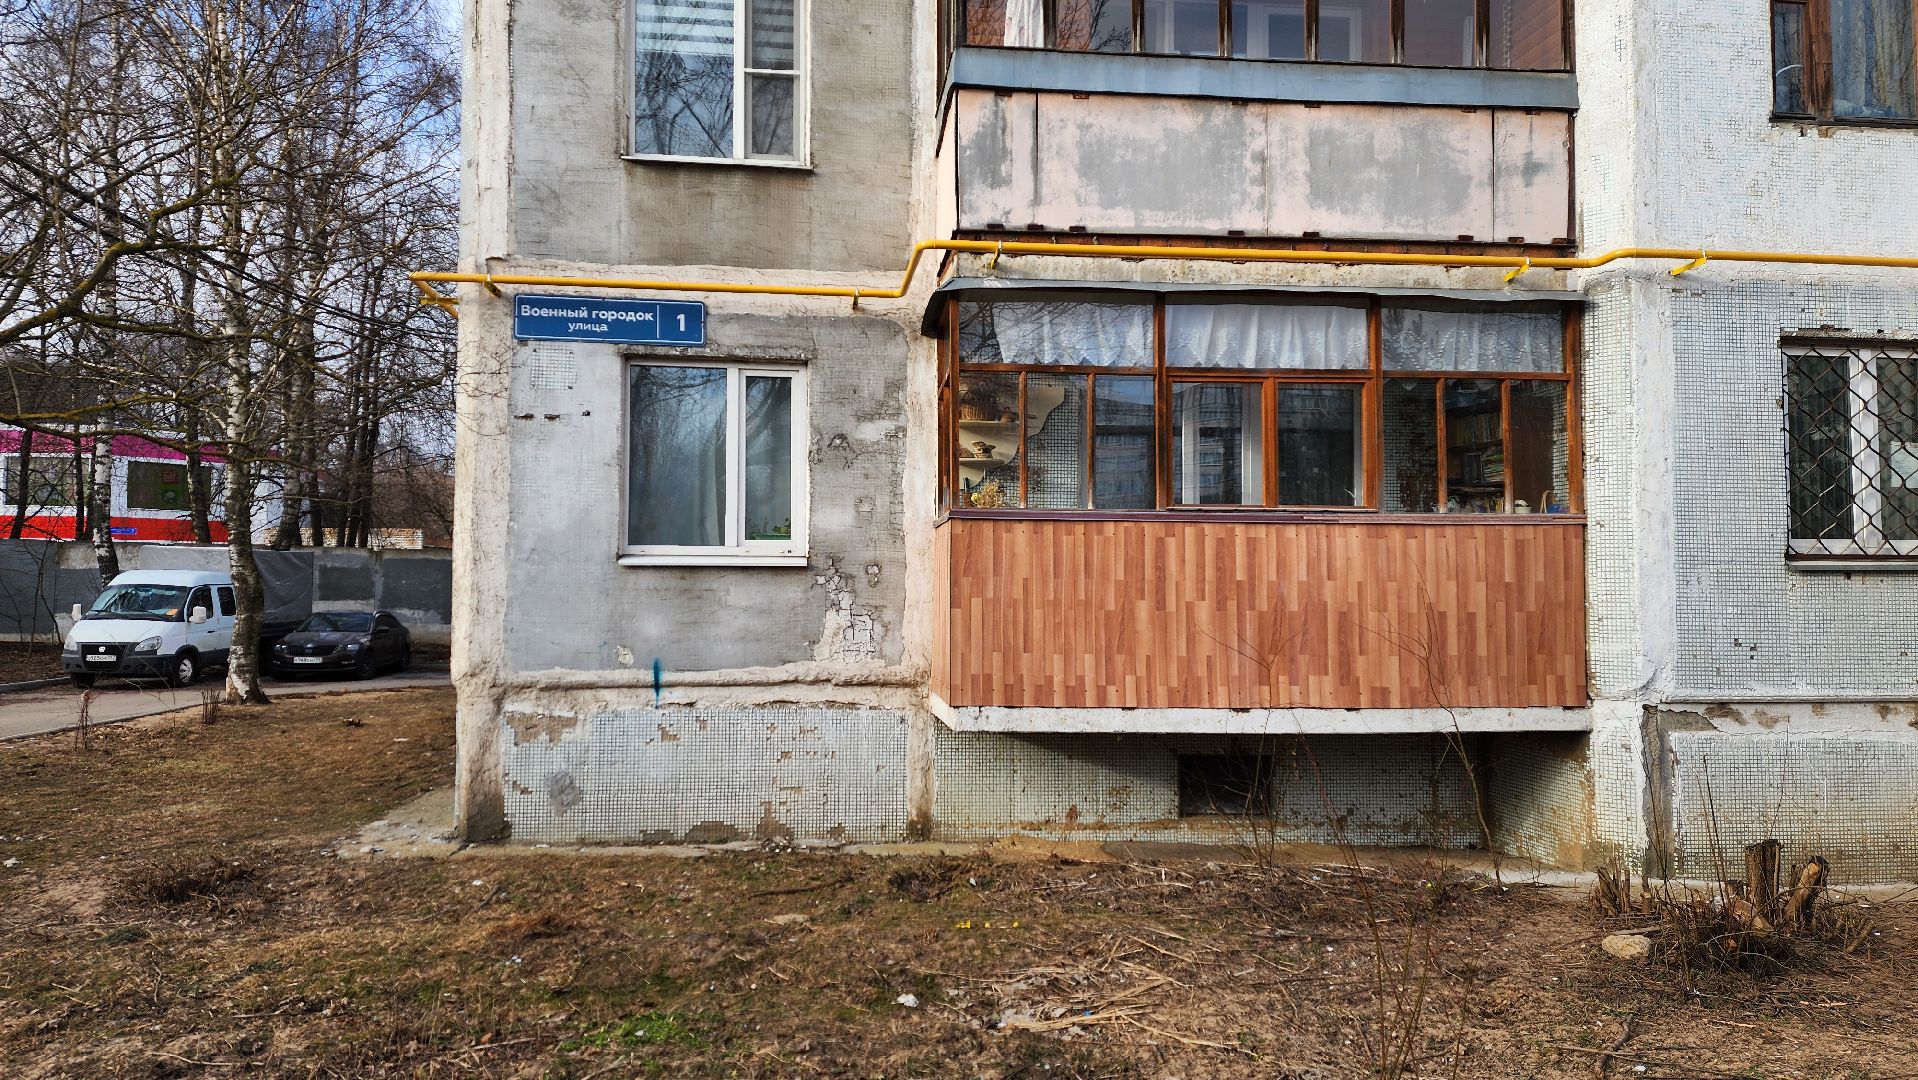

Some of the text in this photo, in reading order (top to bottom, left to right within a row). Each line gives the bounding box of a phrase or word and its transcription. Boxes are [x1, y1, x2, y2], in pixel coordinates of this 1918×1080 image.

[520, 304, 654, 322] Военный городок
[568, 321, 609, 333] улица
[676, 313, 686, 332] 1
